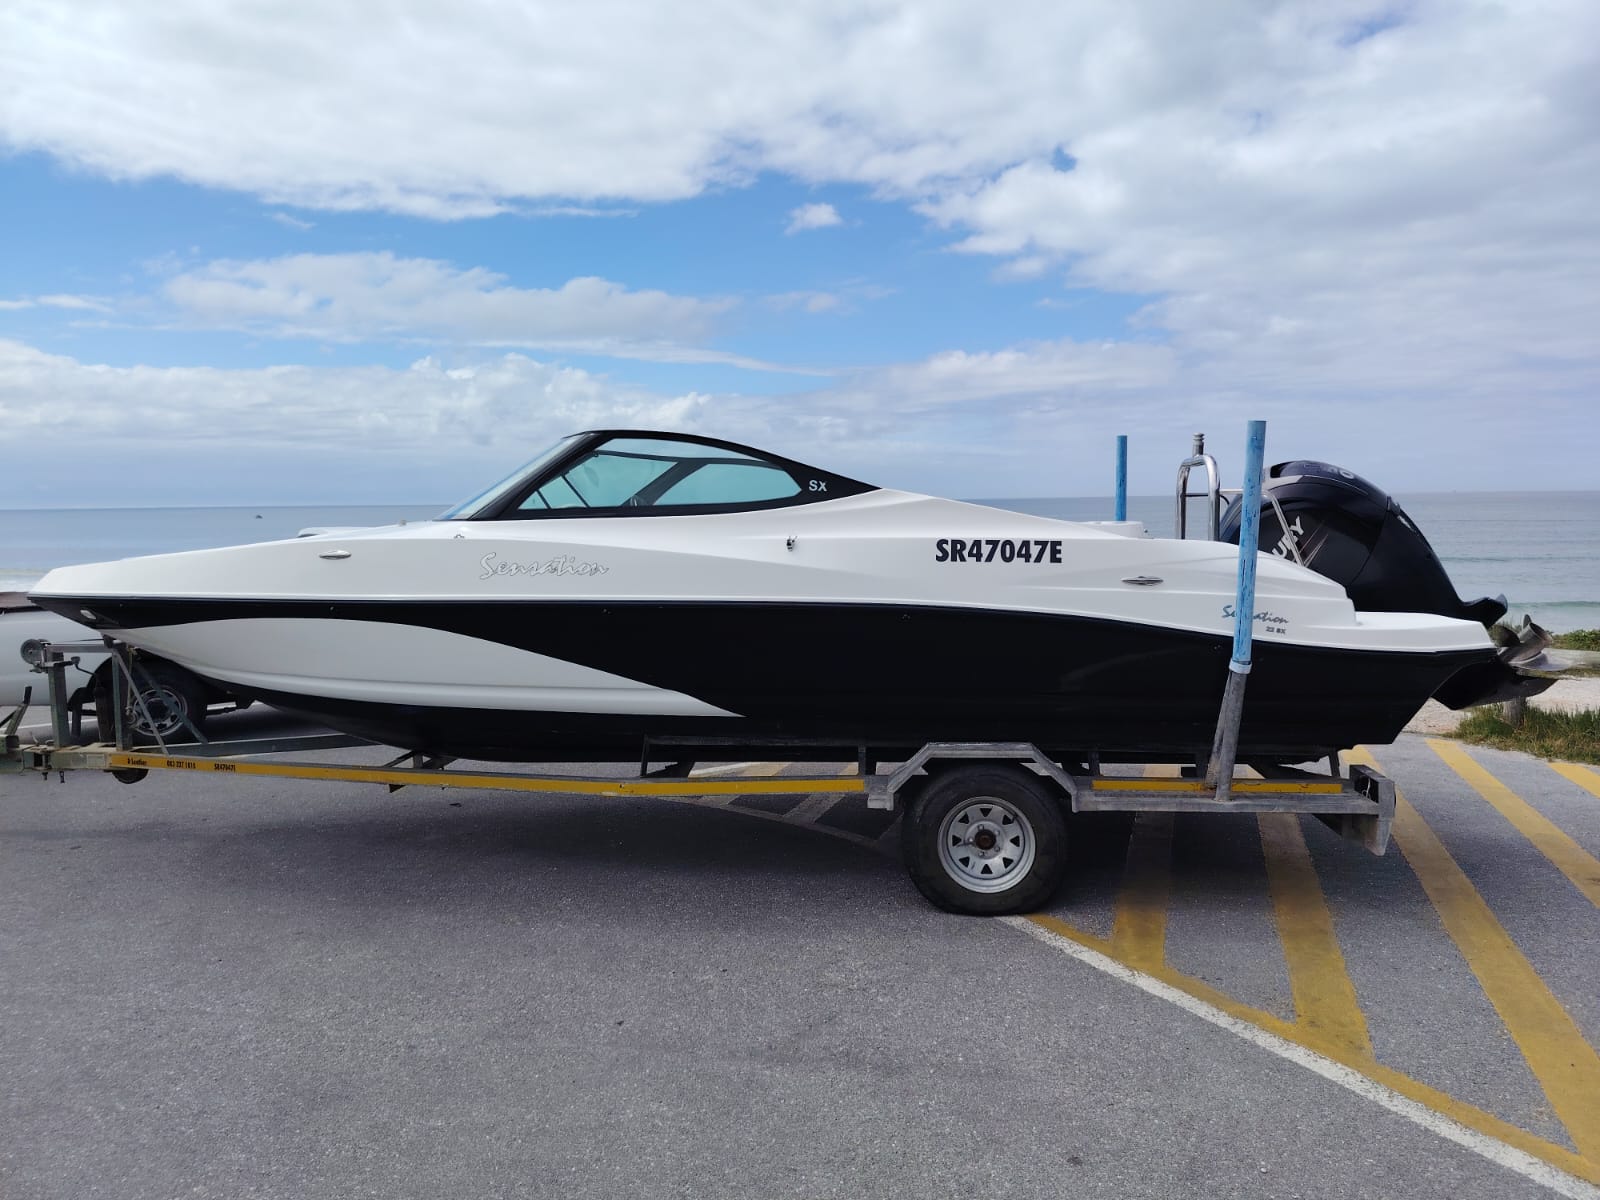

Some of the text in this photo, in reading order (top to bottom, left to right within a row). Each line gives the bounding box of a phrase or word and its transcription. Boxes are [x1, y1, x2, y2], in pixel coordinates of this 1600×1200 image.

[808, 480, 827, 491] SX
[935, 539, 1062, 563] SR47047E
[479, 552, 610, 580] Sensation
[1221, 605, 1289, 624] Seation
